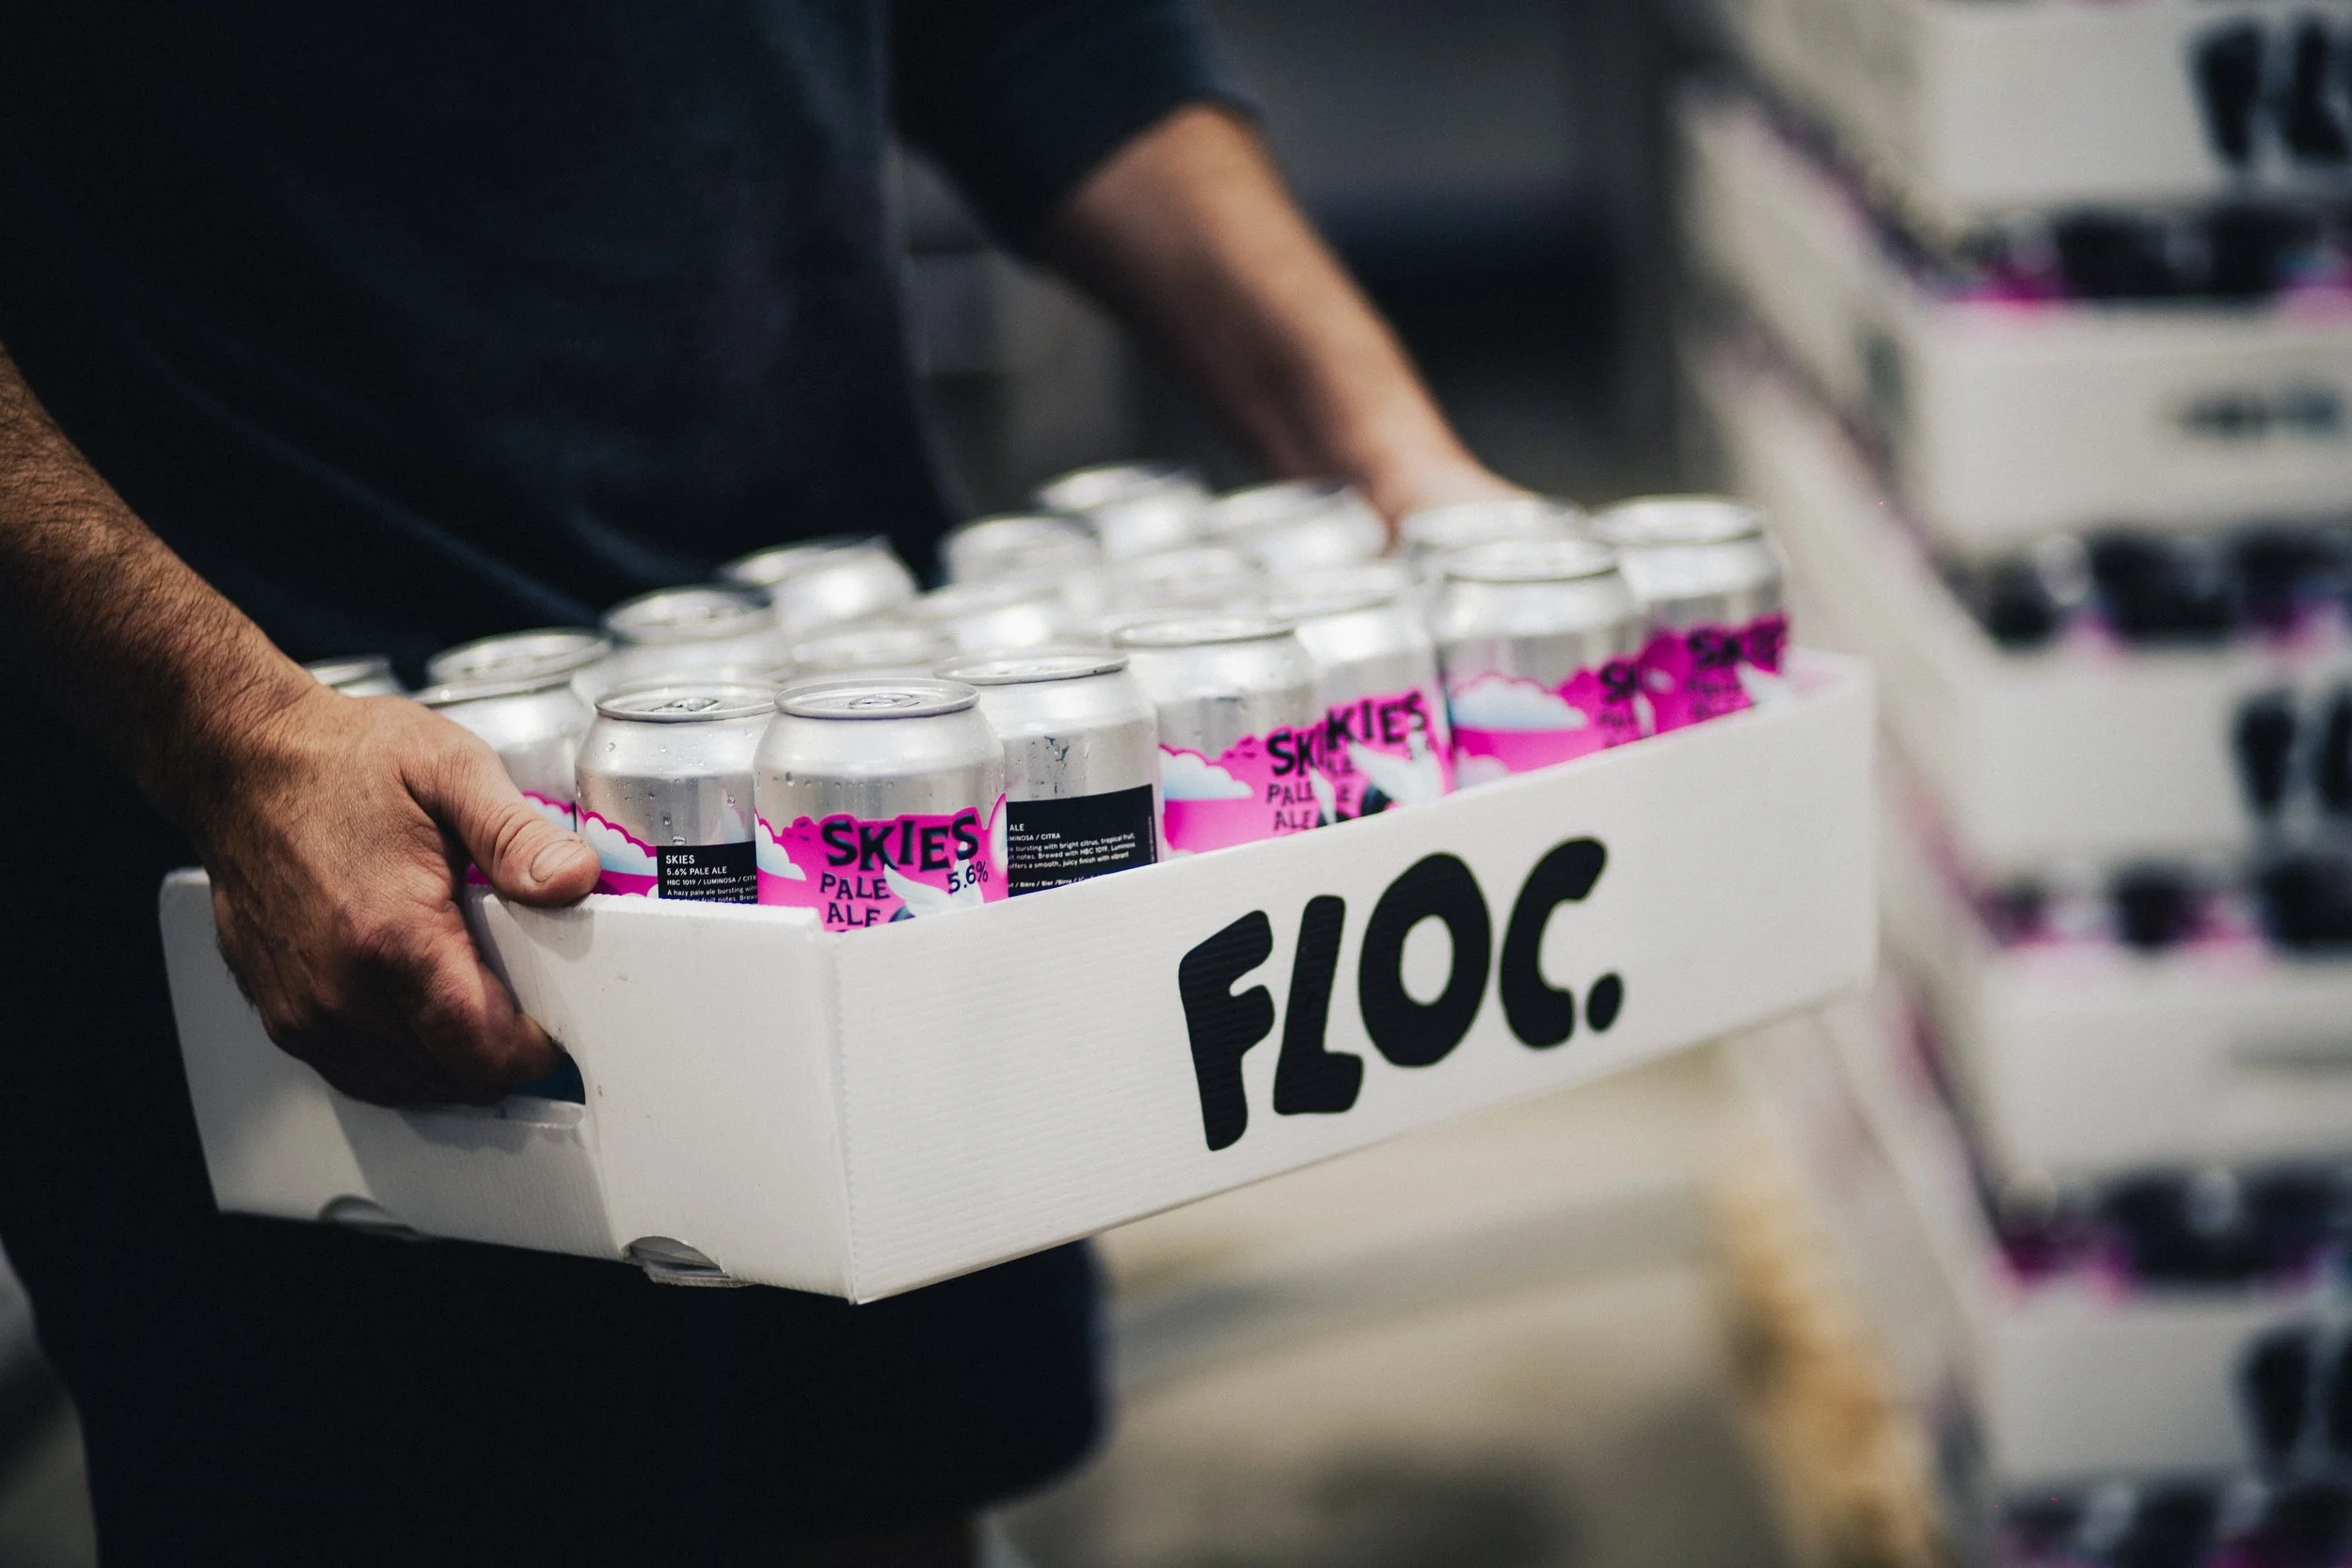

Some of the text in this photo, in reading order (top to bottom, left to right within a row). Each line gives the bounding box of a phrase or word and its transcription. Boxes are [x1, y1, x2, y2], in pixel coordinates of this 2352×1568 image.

[1326, 690, 1424, 751] KIES
[1009, 823, 1025, 832] ALE
[821, 814, 979, 872] SKIES
[665, 854, 695, 864] SKIES
[666, 865, 727, 876] 5.6% PALE ALE
[703, 877, 736, 885] LUMINOSA
[717, 886, 744, 895] bursting
[819, 871, 891, 900] PALE
[946, 861, 989, 895] 5.6%
[826, 901, 882, 928] ALE
[1178, 836, 1624, 1151] FLOC.
